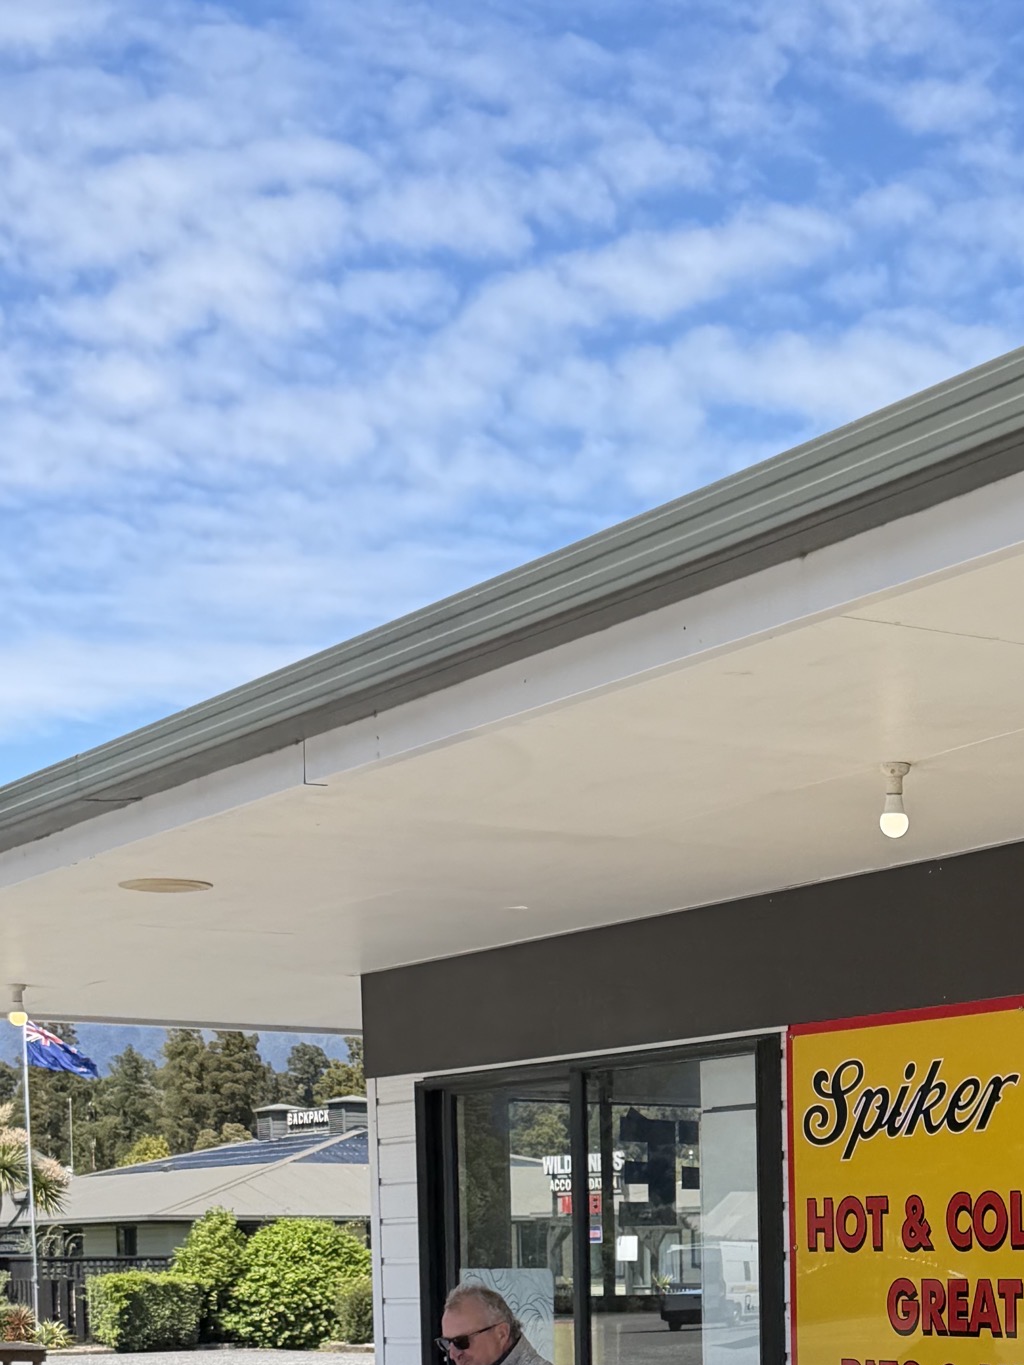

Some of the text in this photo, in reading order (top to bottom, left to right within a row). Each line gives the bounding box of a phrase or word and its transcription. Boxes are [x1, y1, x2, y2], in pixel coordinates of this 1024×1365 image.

[803, 1058, 1020, 1162] Spiker
[806, 1195, 889, 1253] HOT
[901, 1194, 935, 1252] &
[887, 1278, 1024, 1339] GREAT
